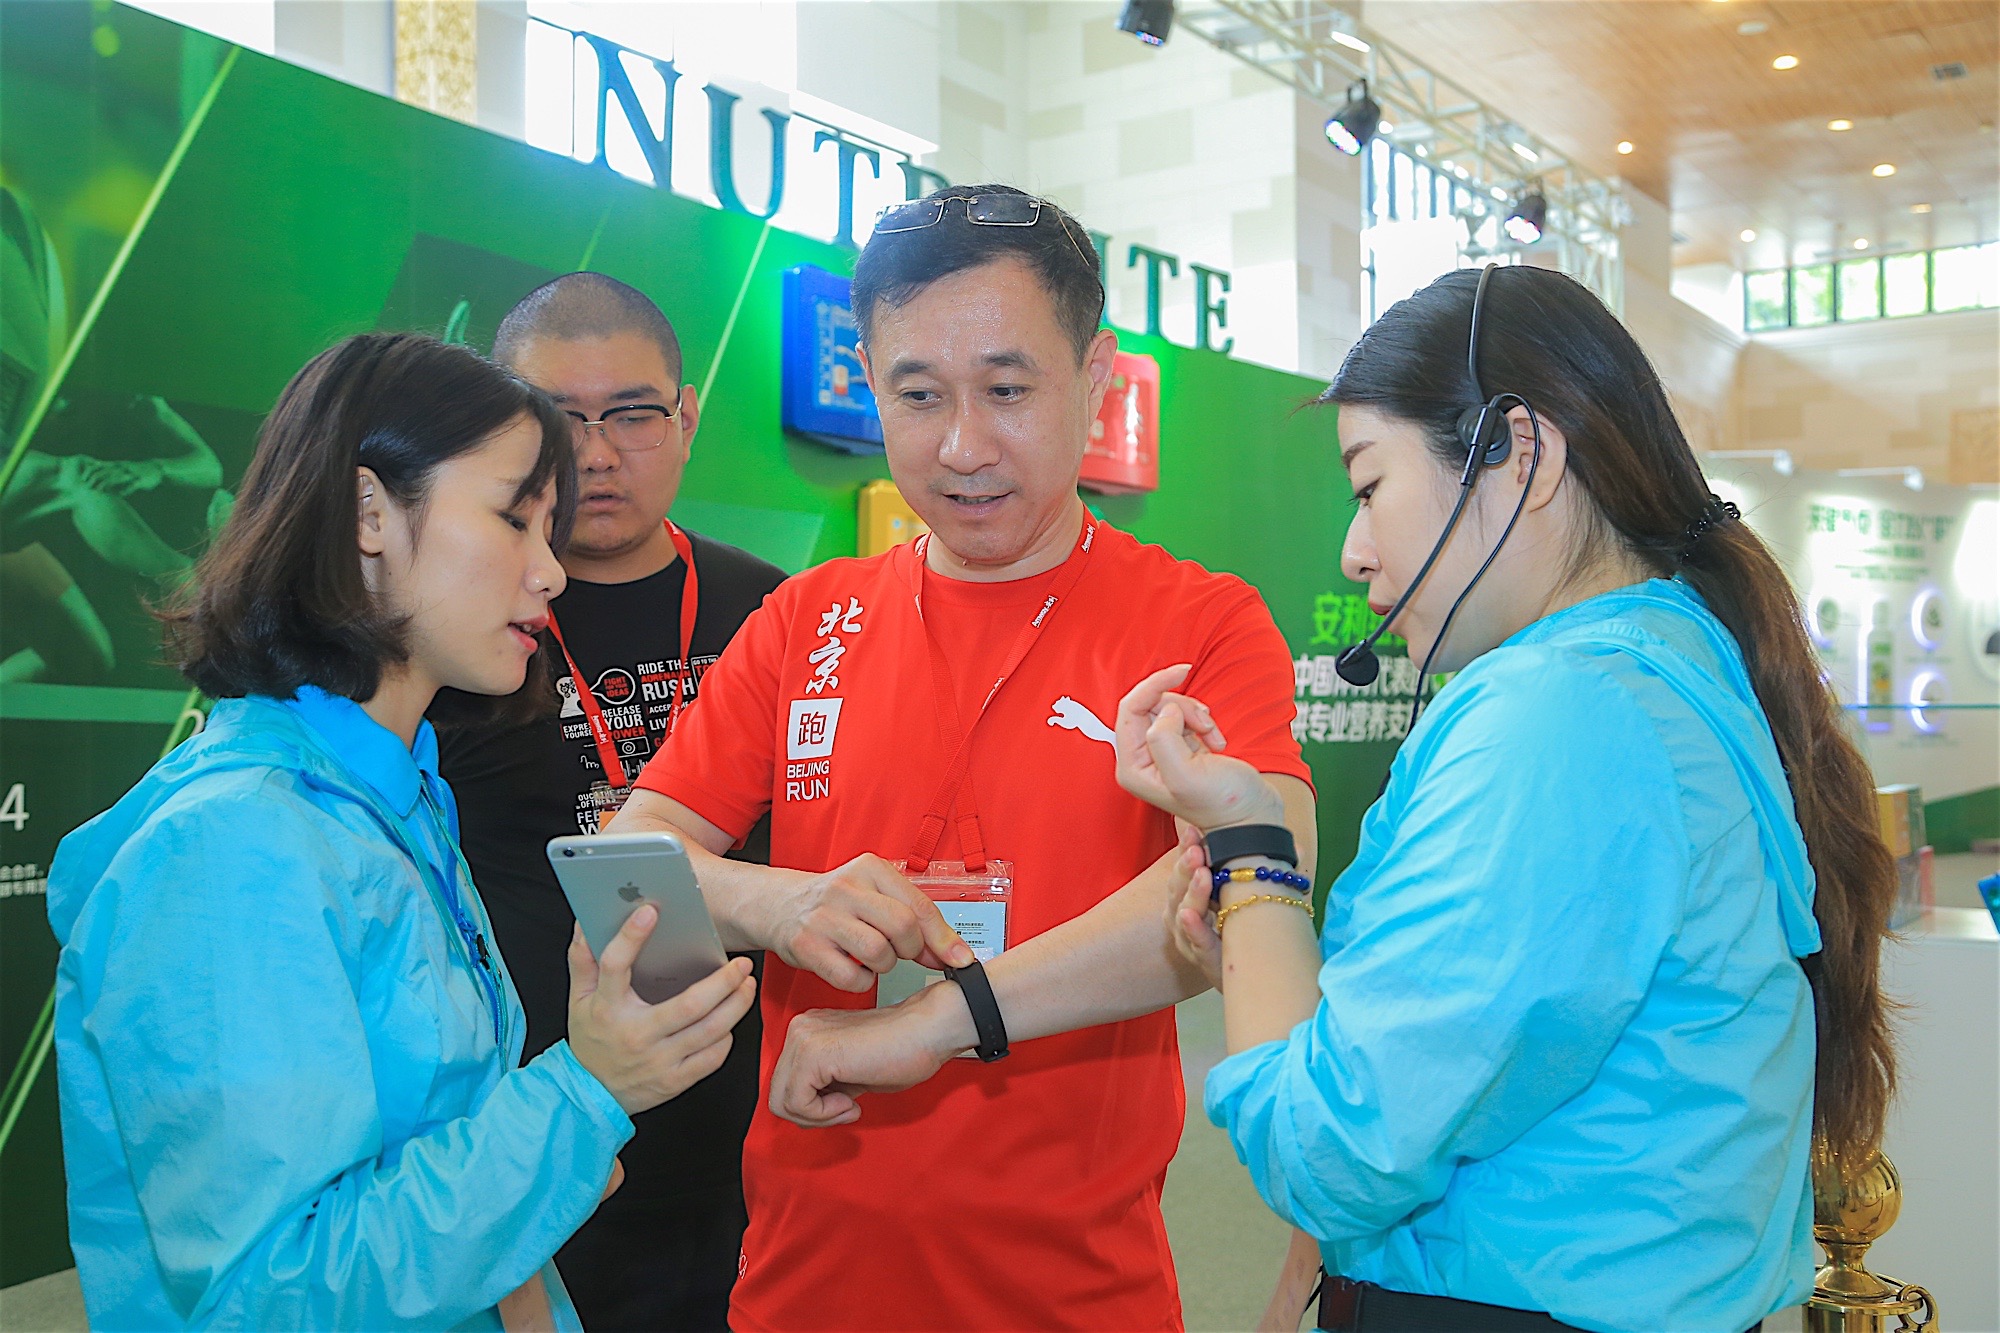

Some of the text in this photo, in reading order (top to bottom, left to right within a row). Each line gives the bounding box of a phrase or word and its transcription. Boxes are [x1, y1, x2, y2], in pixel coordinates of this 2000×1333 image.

[806, 596, 864, 695] 北京
[637, 661, 665, 676] RIDE
[606, 687, 629, 697] IDEAS
[641, 677, 696, 702] RUSH
[601, 704, 642, 718] RELEASE
[649, 704, 673, 714] ACCEP
[604, 714, 644, 731] YOUR
[798, 712, 827, 746] 跑
[611, 727, 646, 740] OWER
[787, 761, 830, 779] BEIJING
[786, 778, 829, 802] RUN
